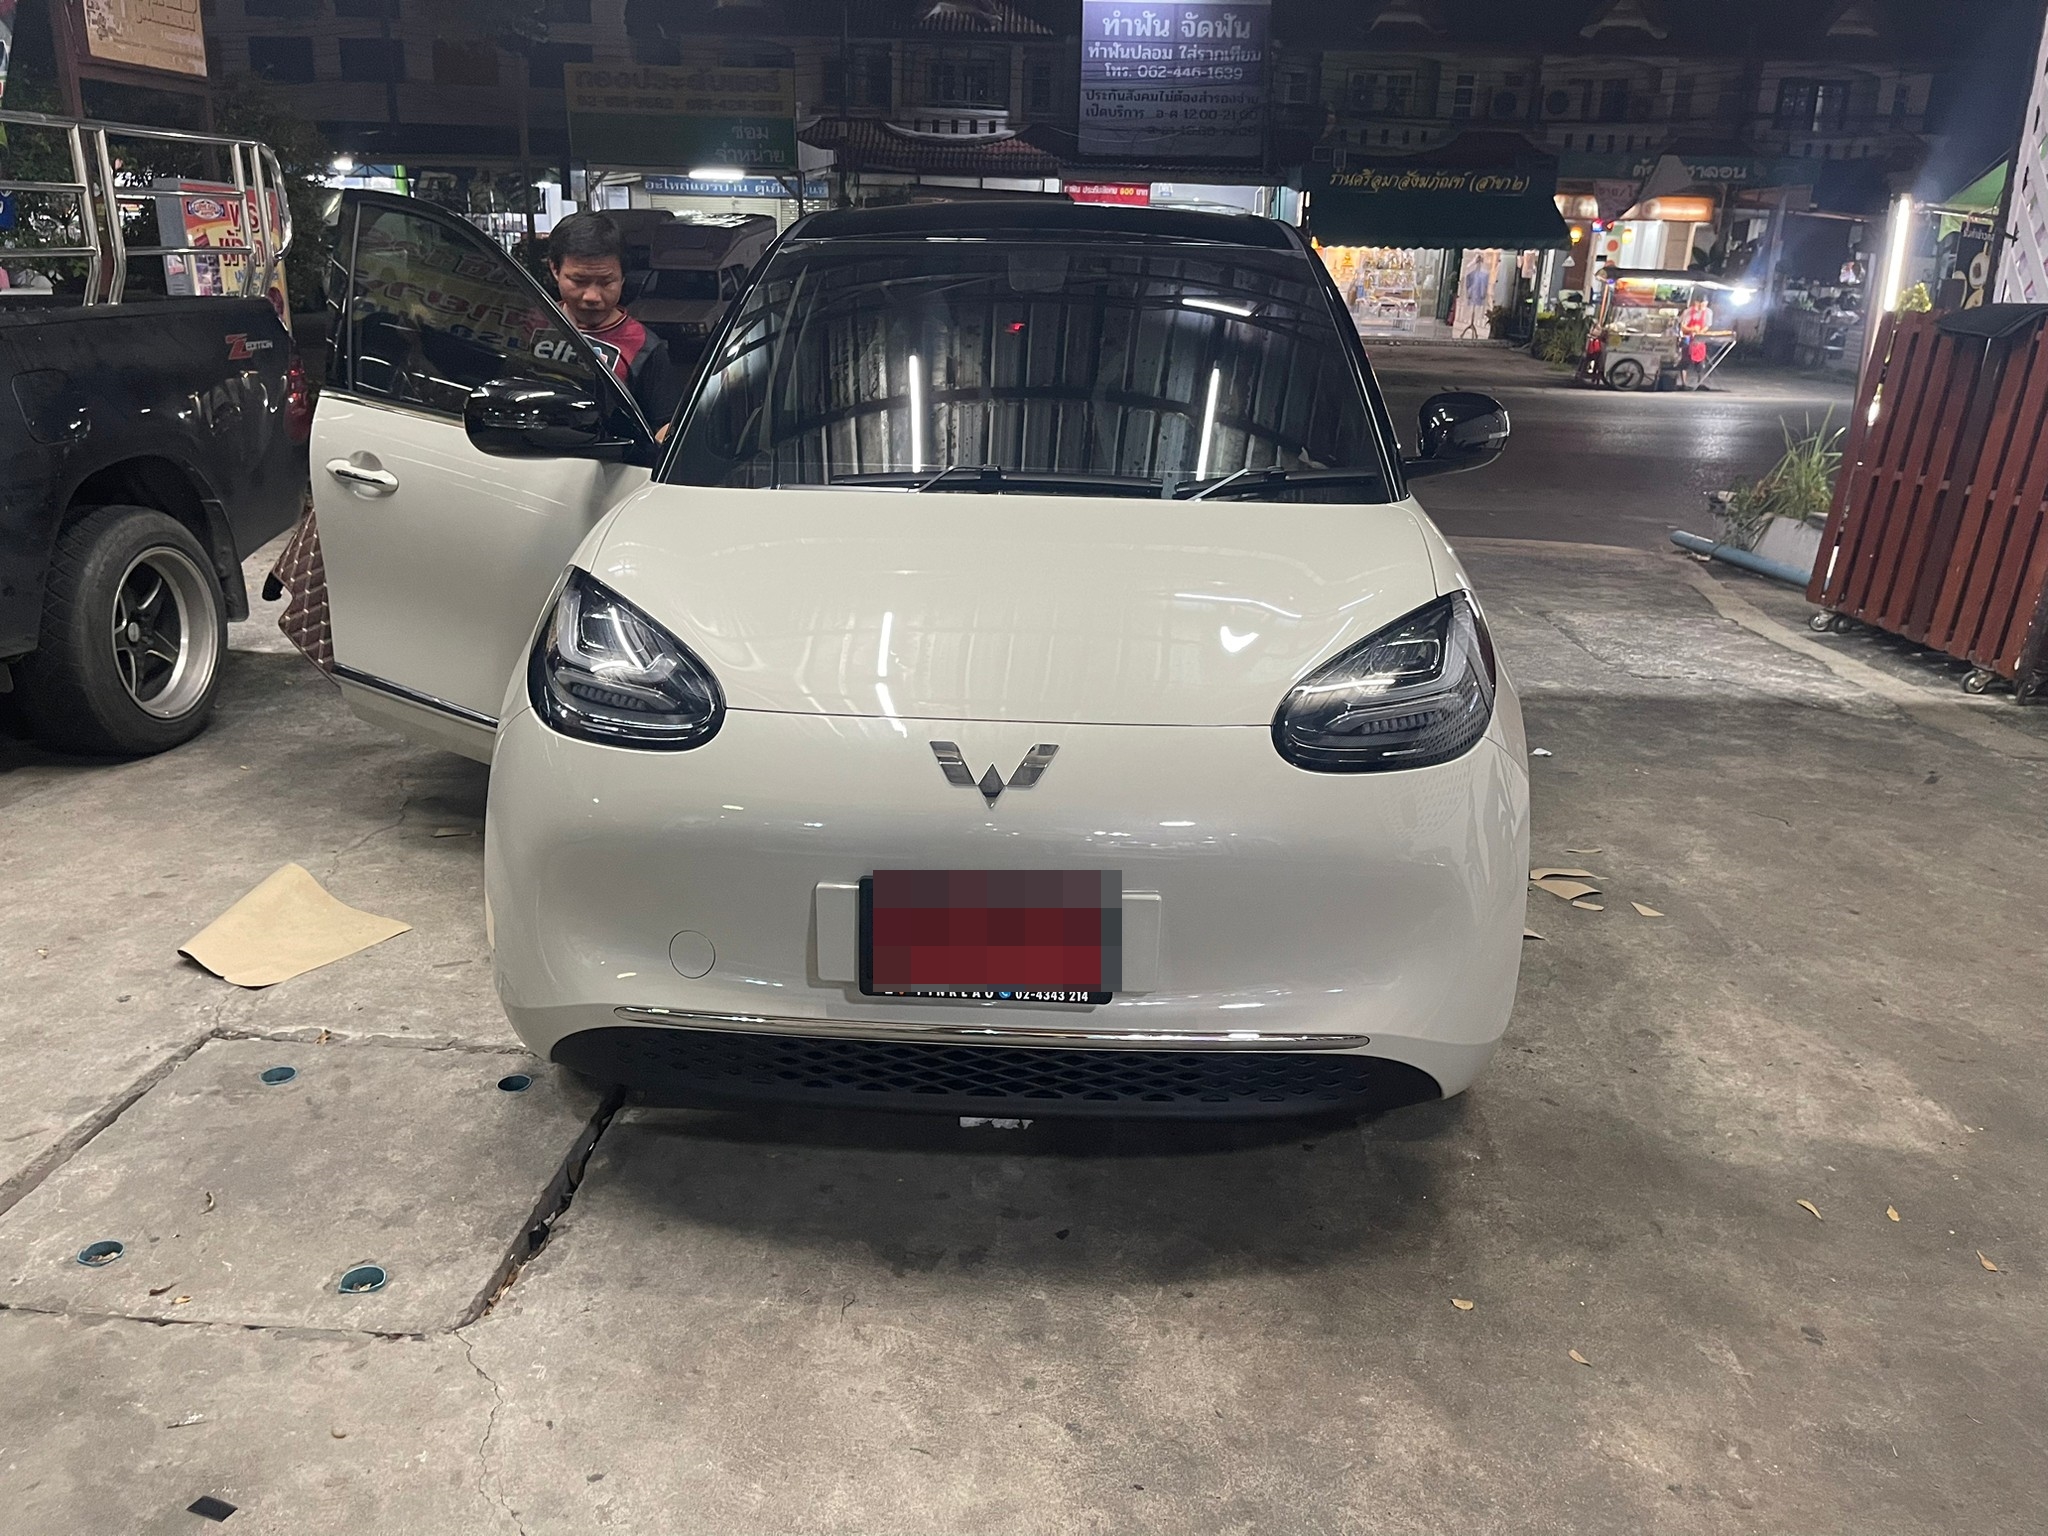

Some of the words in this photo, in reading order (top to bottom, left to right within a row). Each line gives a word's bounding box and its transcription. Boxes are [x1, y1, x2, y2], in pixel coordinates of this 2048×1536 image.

[1102, 10, 1170, 37] ทำฟัน
[1181, 12, 1250, 39] จัดฟัน
[1088, 42, 1173, 60] ทำฟันปลอม
[1068, 991, 1089, 1002] 214
